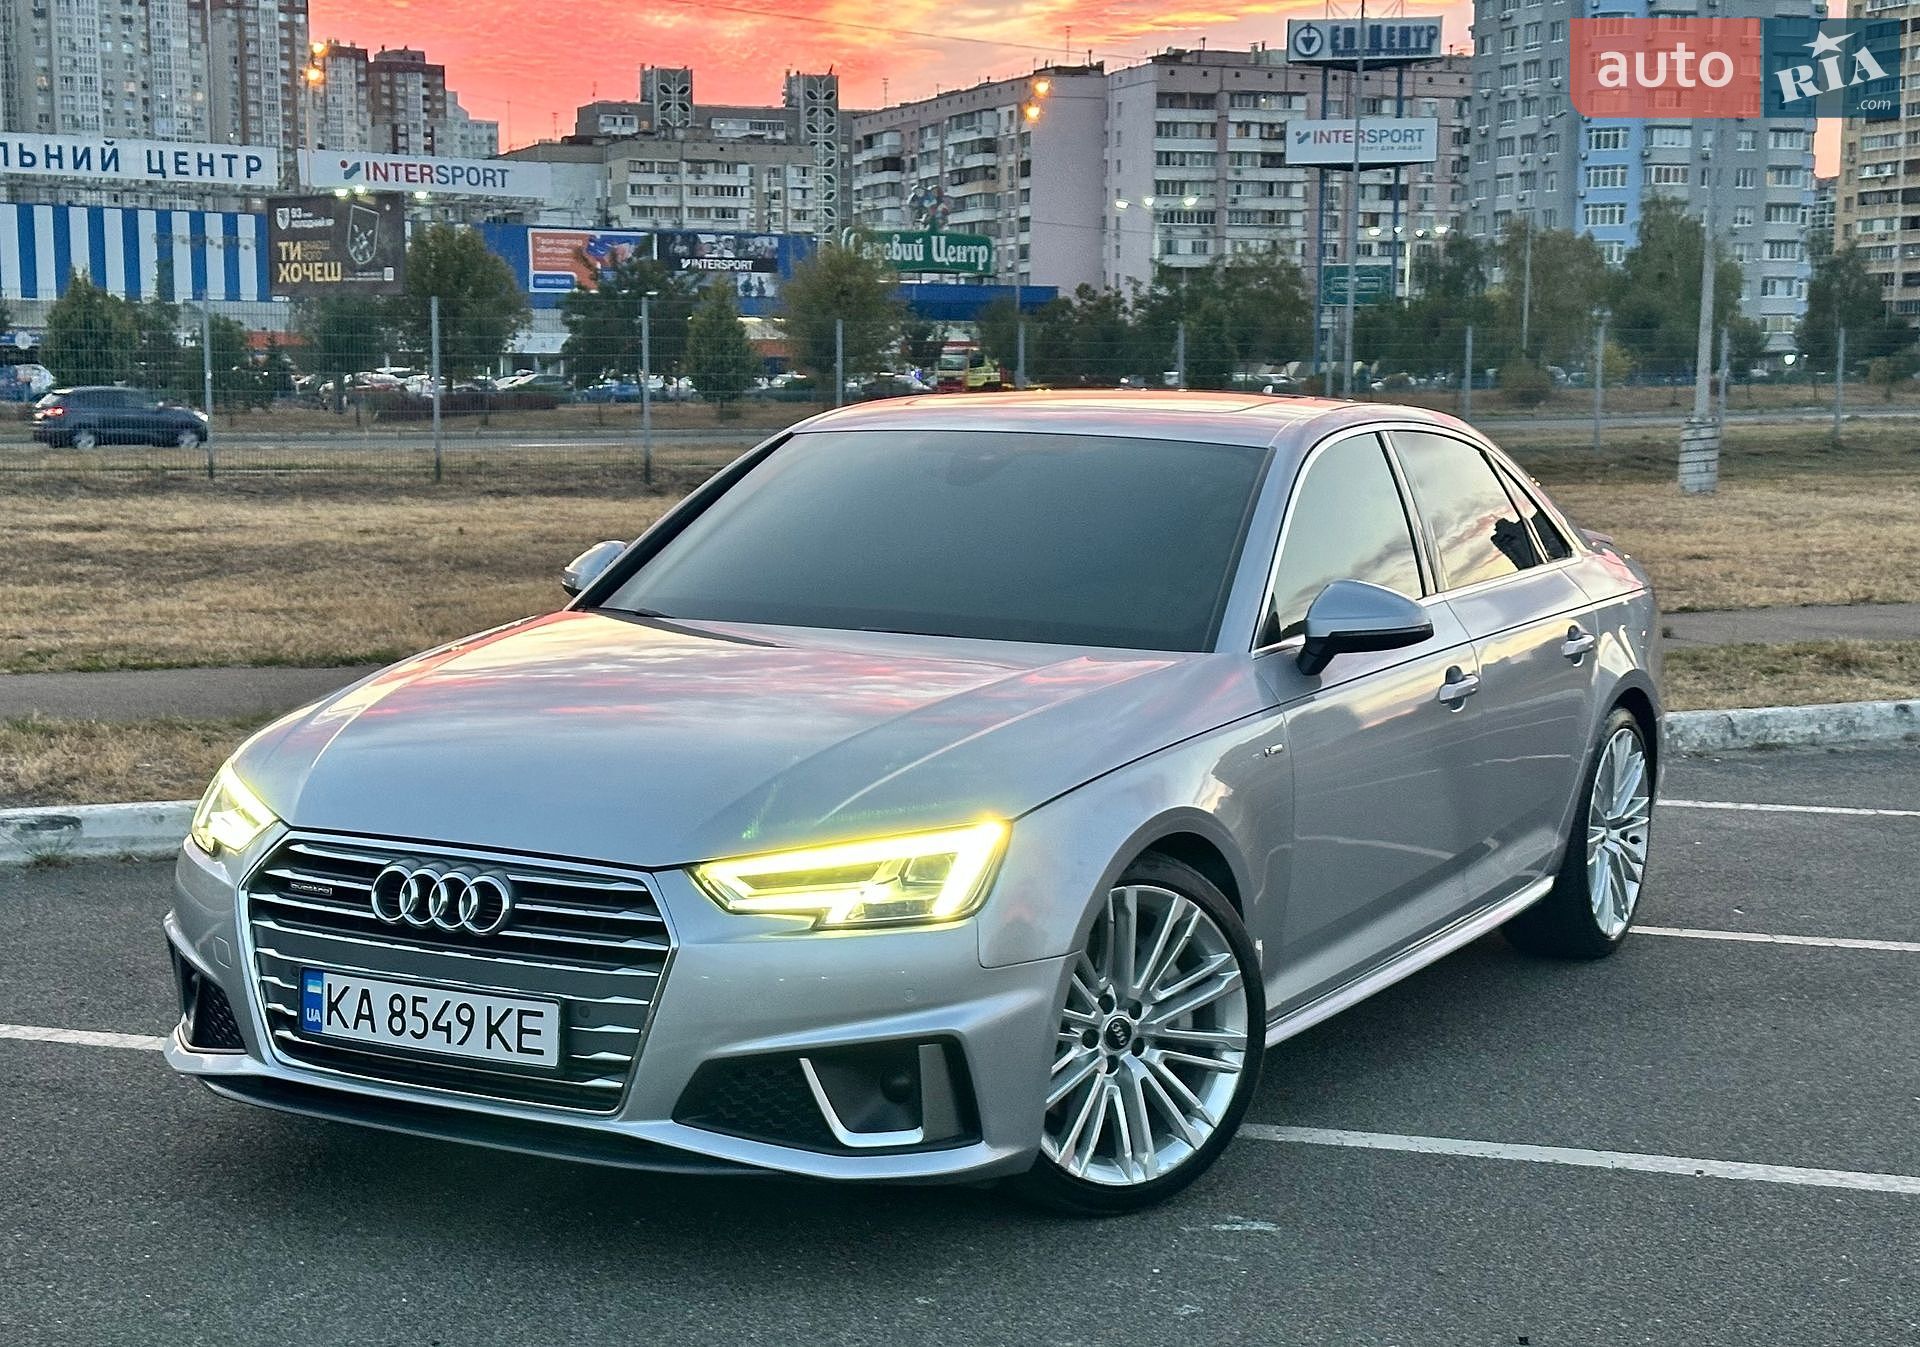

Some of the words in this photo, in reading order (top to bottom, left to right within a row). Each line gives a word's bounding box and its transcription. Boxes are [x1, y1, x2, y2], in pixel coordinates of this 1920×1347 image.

[1330, 24, 1438, 49] ЕПЦЕНТР
[1313, 128, 1425, 144] INTERSPORT
[147, 149, 262, 178] ЦЕНТР
[365, 160, 511, 188] INTERSPORT
[277, 241, 301, 261] ТИ
[931, 235, 988, 271] Центр
[278, 262, 342, 283] ХОЧЕШ
[691, 259, 754, 270] INTERSPORT
[306, 1008, 322, 1023] UA
[326, 983, 376, 1033] KA
[387, 993, 476, 1046] 8549
[486, 1005, 545, 1056] KE
